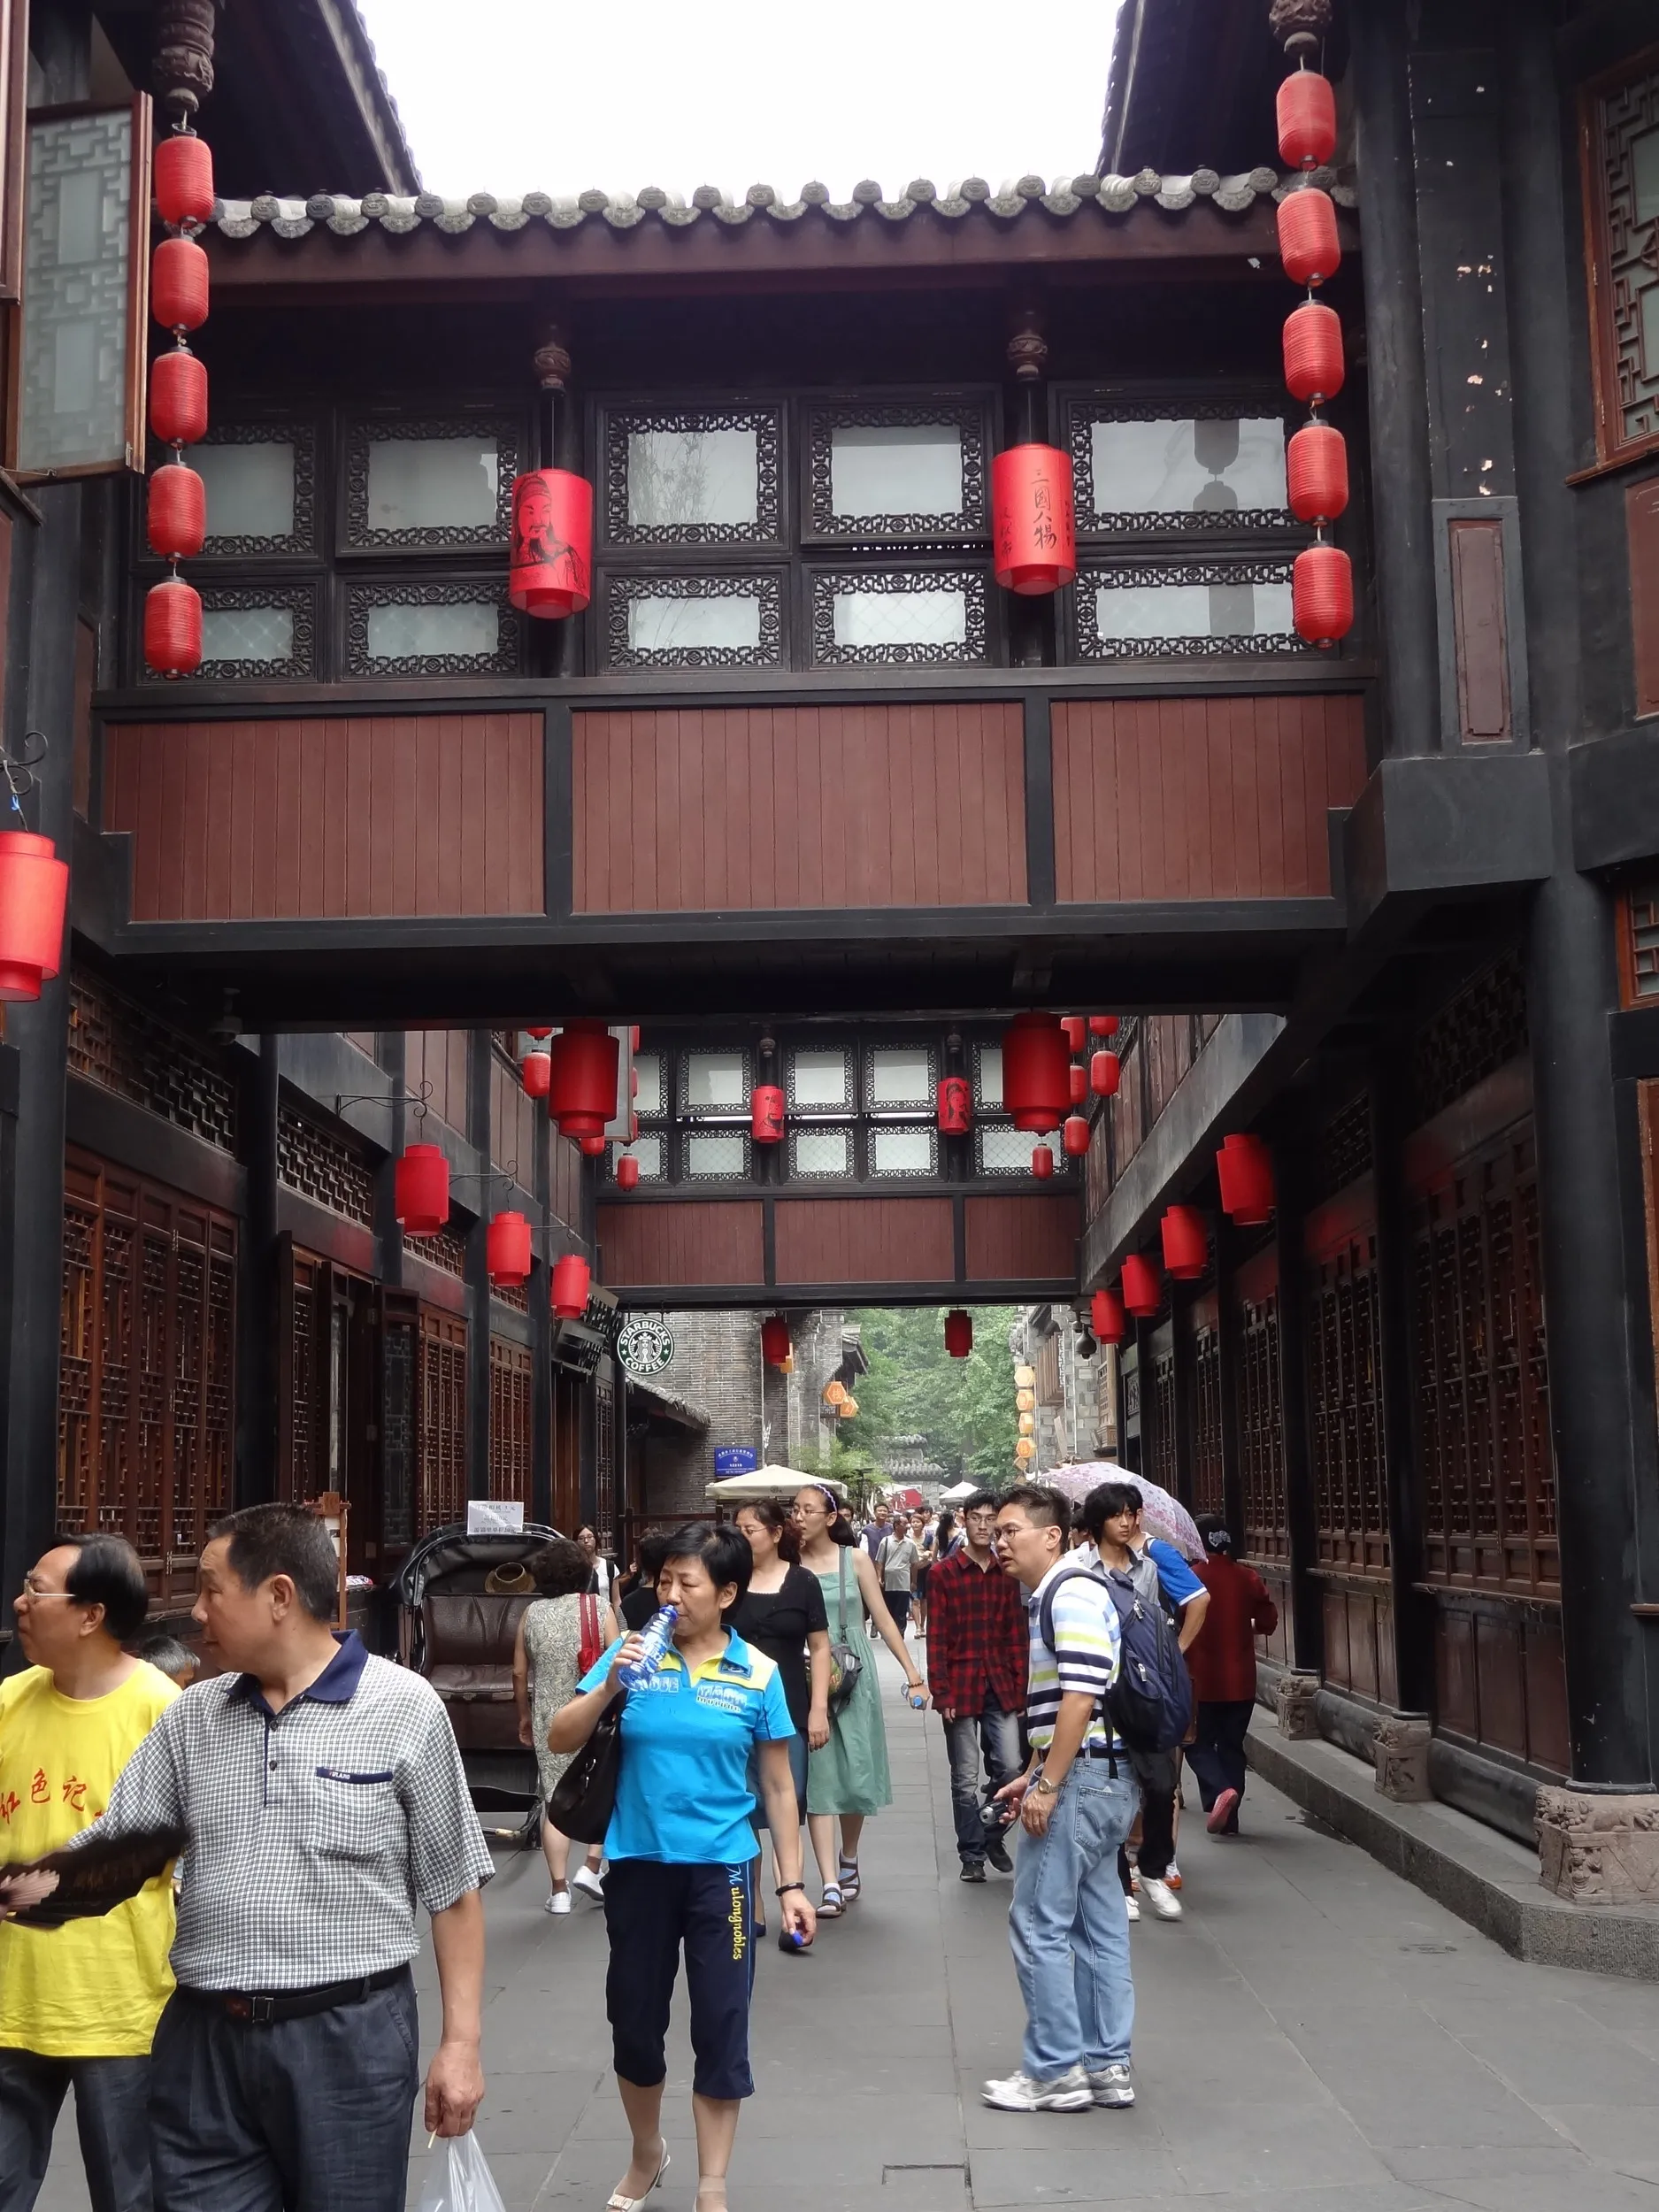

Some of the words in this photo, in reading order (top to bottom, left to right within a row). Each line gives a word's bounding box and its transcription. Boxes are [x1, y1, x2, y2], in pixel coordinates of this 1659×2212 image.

[620, 1321, 671, 1346] STARBUCKS
[625, 1357, 664, 1372] COFFEE
[0, 1767, 104, 1825] 红色记
